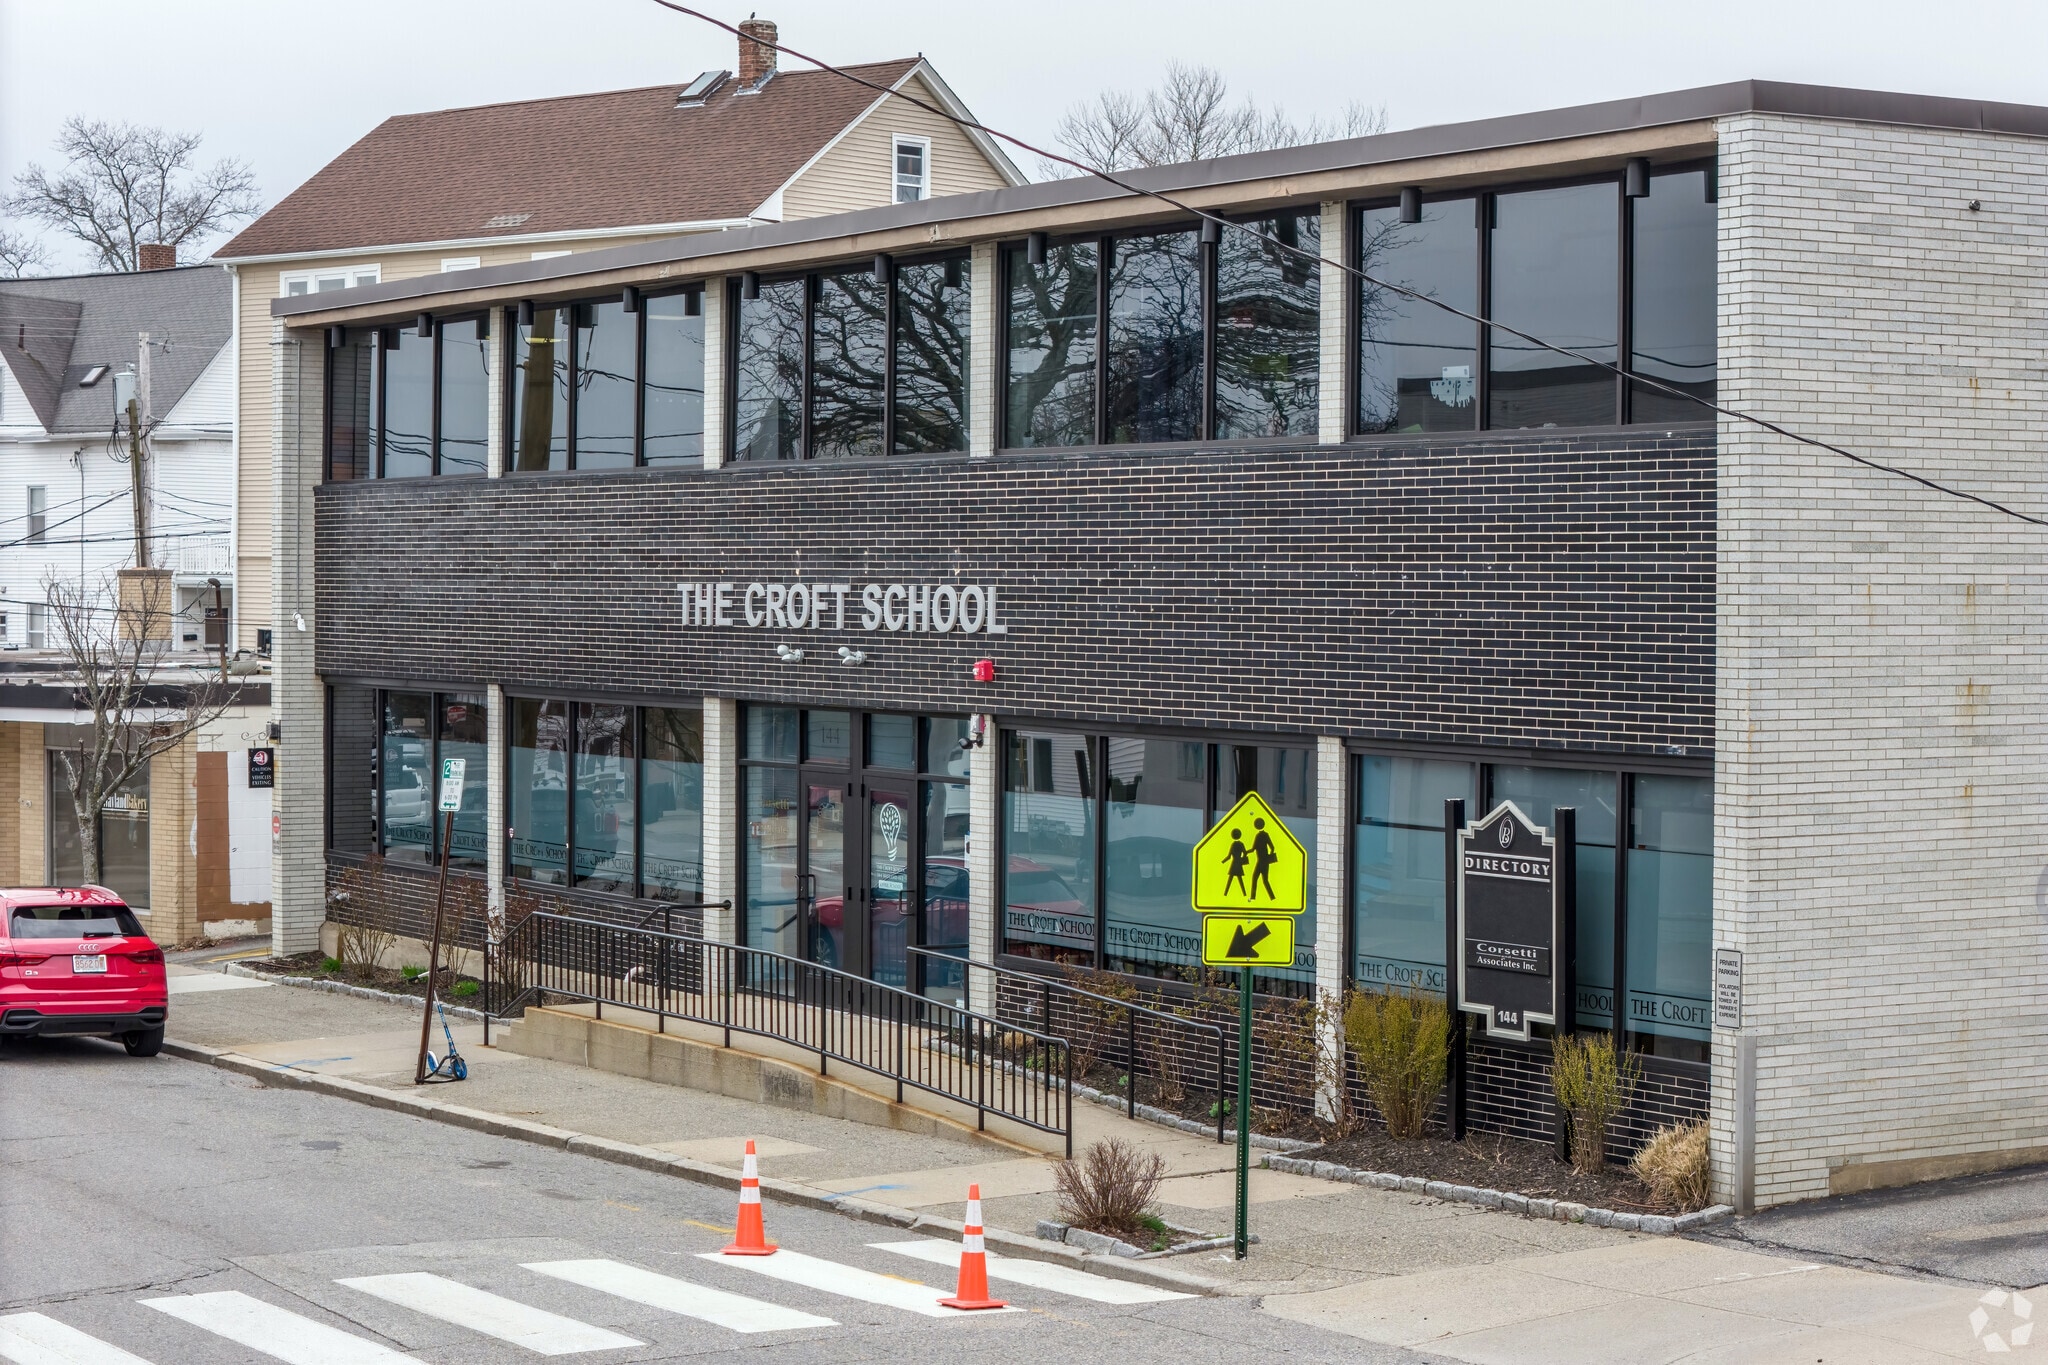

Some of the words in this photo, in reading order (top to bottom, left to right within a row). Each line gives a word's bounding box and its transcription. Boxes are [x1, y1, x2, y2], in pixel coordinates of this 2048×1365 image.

[677, 583, 734, 627] THE
[744, 582, 850, 630] CROFT
[862, 584, 1008, 635] SCHOOL
[822, 726, 840, 744] 144
[444, 761, 451, 775] 2
[514, 844, 524, 854] THE
[546, 846, 567, 860] SCHOO
[611, 857, 634, 872] SCHOO
[645, 862, 656, 874] THE
[658, 863, 680, 878] CROFT
[1465, 857, 1550, 876] DIRECTORY
[1008, 912, 1026, 927] THE
[1027, 913, 1059, 932] CROFT
[1108, 926, 1128, 942] THE
[1130, 928, 1162, 947] CROFT
[1476, 943, 1537, 958] Corsetti
[1476, 956, 1520, 969] Associates
[1522, 961, 1537, 972] Inc.
[1719, 959, 1738, 968] PRIVATE
[1360, 962, 1382, 978] THE
[1385, 964, 1423, 984] CROFT
[1718, 968, 1739, 976] PARKING
[1498, 1010, 1518, 1026] 144
[1632, 999, 1658, 1017] THE
[1662, 1001, 1706, 1024] CROFT
